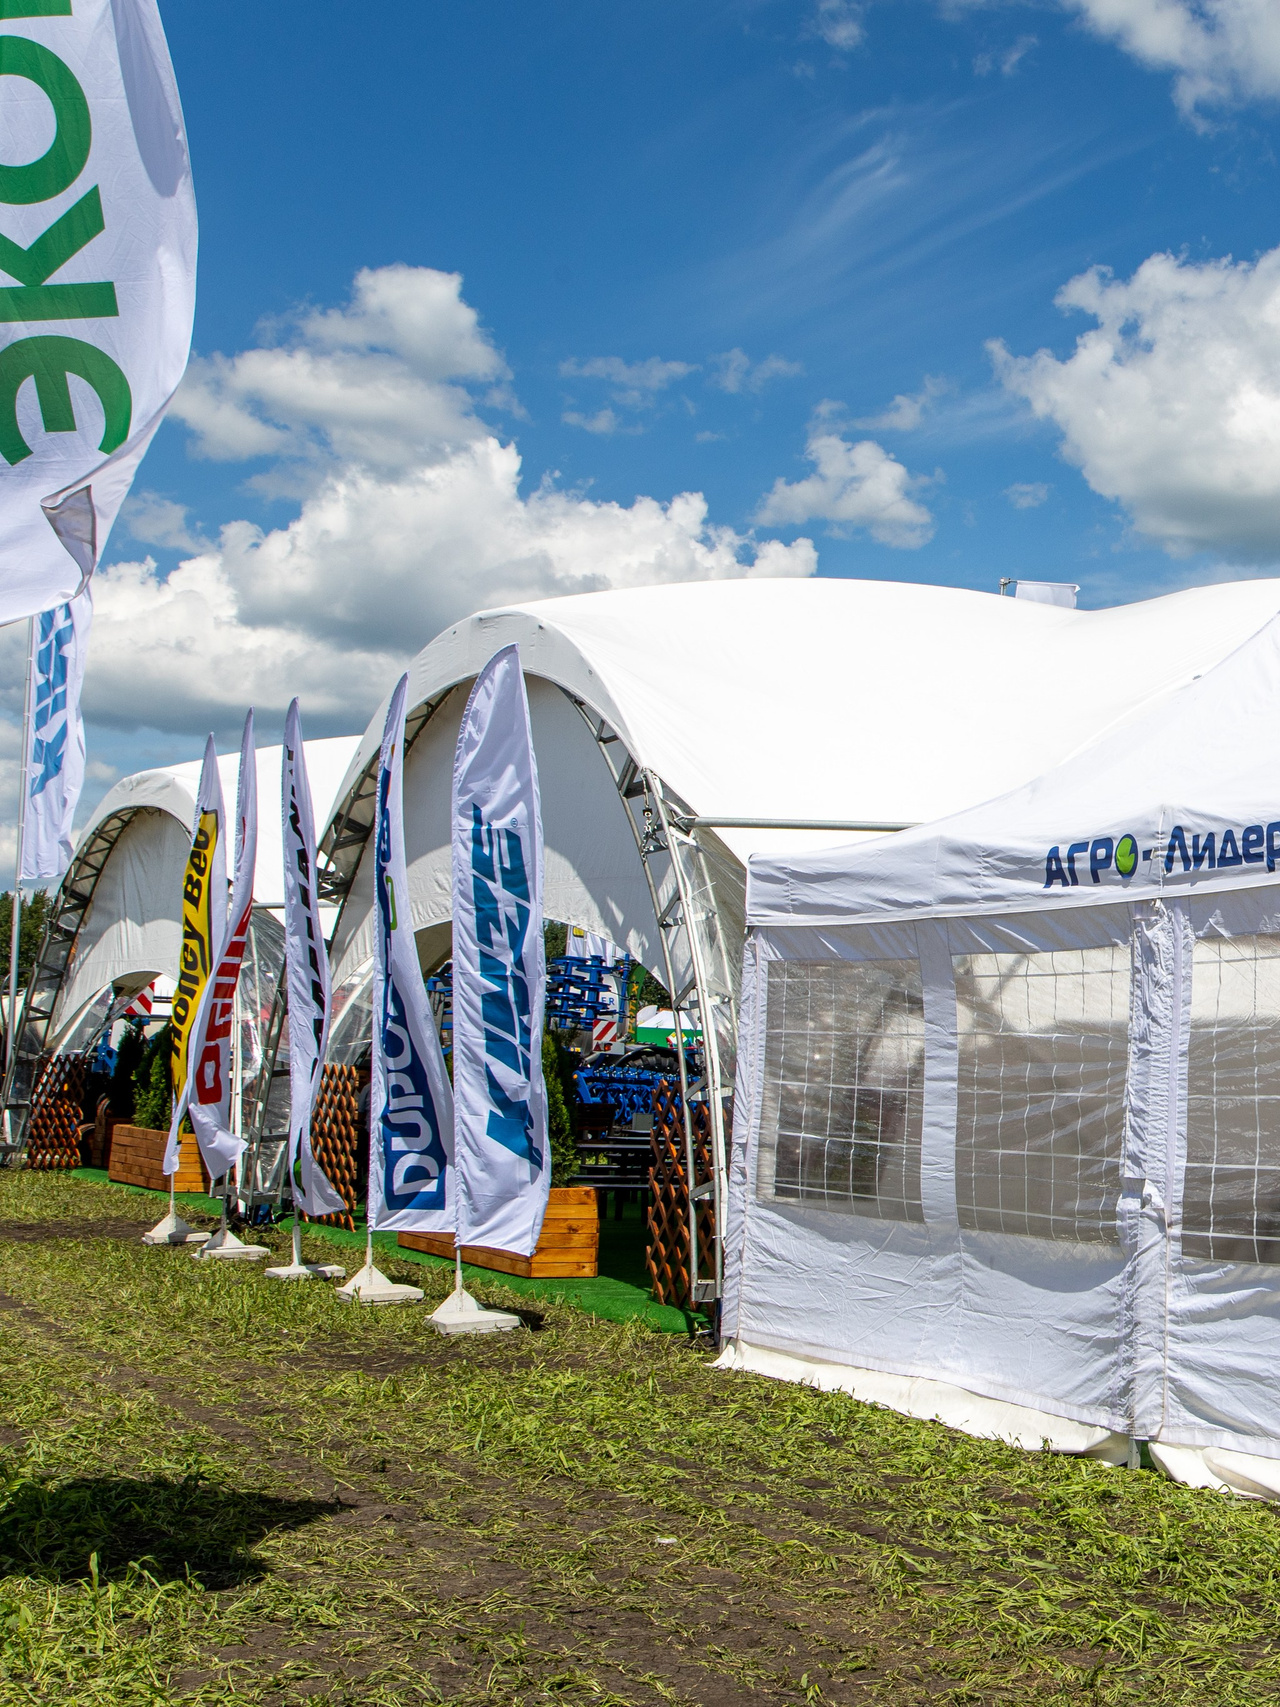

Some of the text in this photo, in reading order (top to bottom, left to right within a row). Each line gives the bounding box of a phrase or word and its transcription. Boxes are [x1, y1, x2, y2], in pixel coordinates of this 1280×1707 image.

[0, 0, 132, 467] ЭКО
[383, 945, 438, 1196] DUPO
[471, 802, 543, 1171] KINZE
